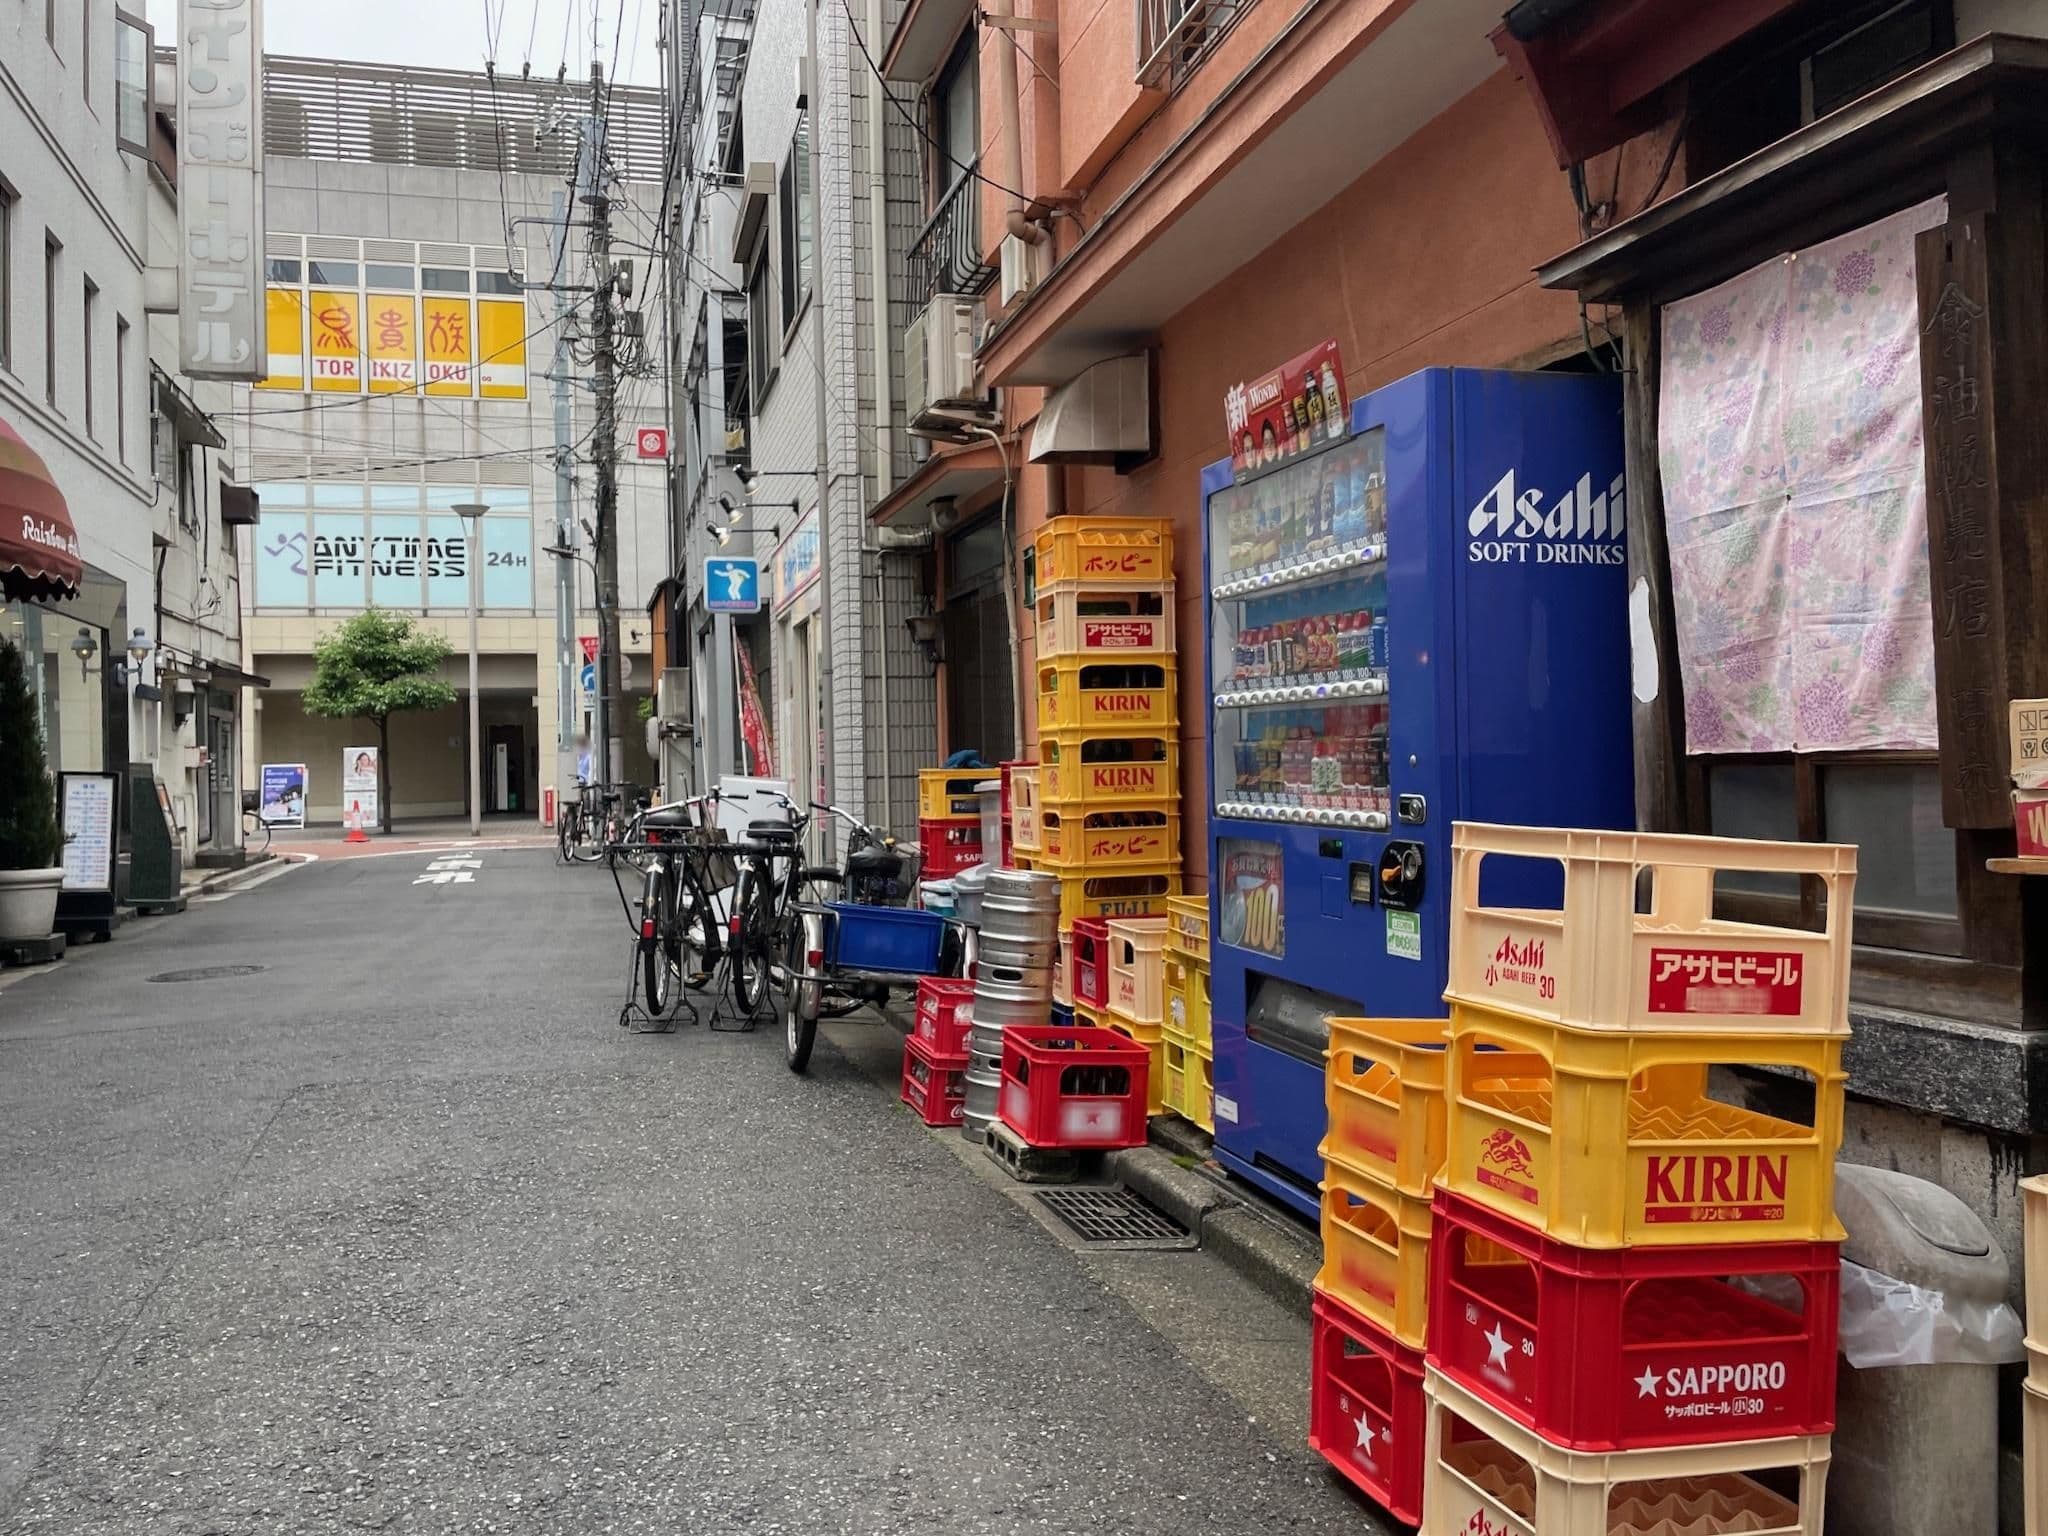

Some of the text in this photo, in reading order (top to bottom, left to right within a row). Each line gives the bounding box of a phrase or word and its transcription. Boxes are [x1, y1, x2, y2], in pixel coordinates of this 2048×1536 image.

[1227, 380, 1248, 432] 新
[1468, 467, 1625, 540] Asahi
[313, 536, 465, 559] ANYTIME
[1469, 542, 1625, 565] SOFT DRINKS
[314, 559, 465, 577] FITNESS
[487, 551, 527, 567] 24H
[1087, 624, 1151, 636] アサヒビール
[1095, 694, 1151, 711] KIRIN
[1093, 767, 1154, 787] KIRIN
[1099, 901, 1151, 917] FUJI
[1496, 933, 1544, 970] Asahi
[1503, 967, 1536, 985] ASAHI BEER
[1655, 953, 1799, 986] アサヒビール
[1540, 975, 1555, 999] 30
[1644, 1155, 1788, 1203] KIRIN
[1521, 1337, 1534, 1357] 30
[1665, 1361, 1786, 1398] SAPPORO
[1664, 1401, 1731, 1418] サッポロビール
